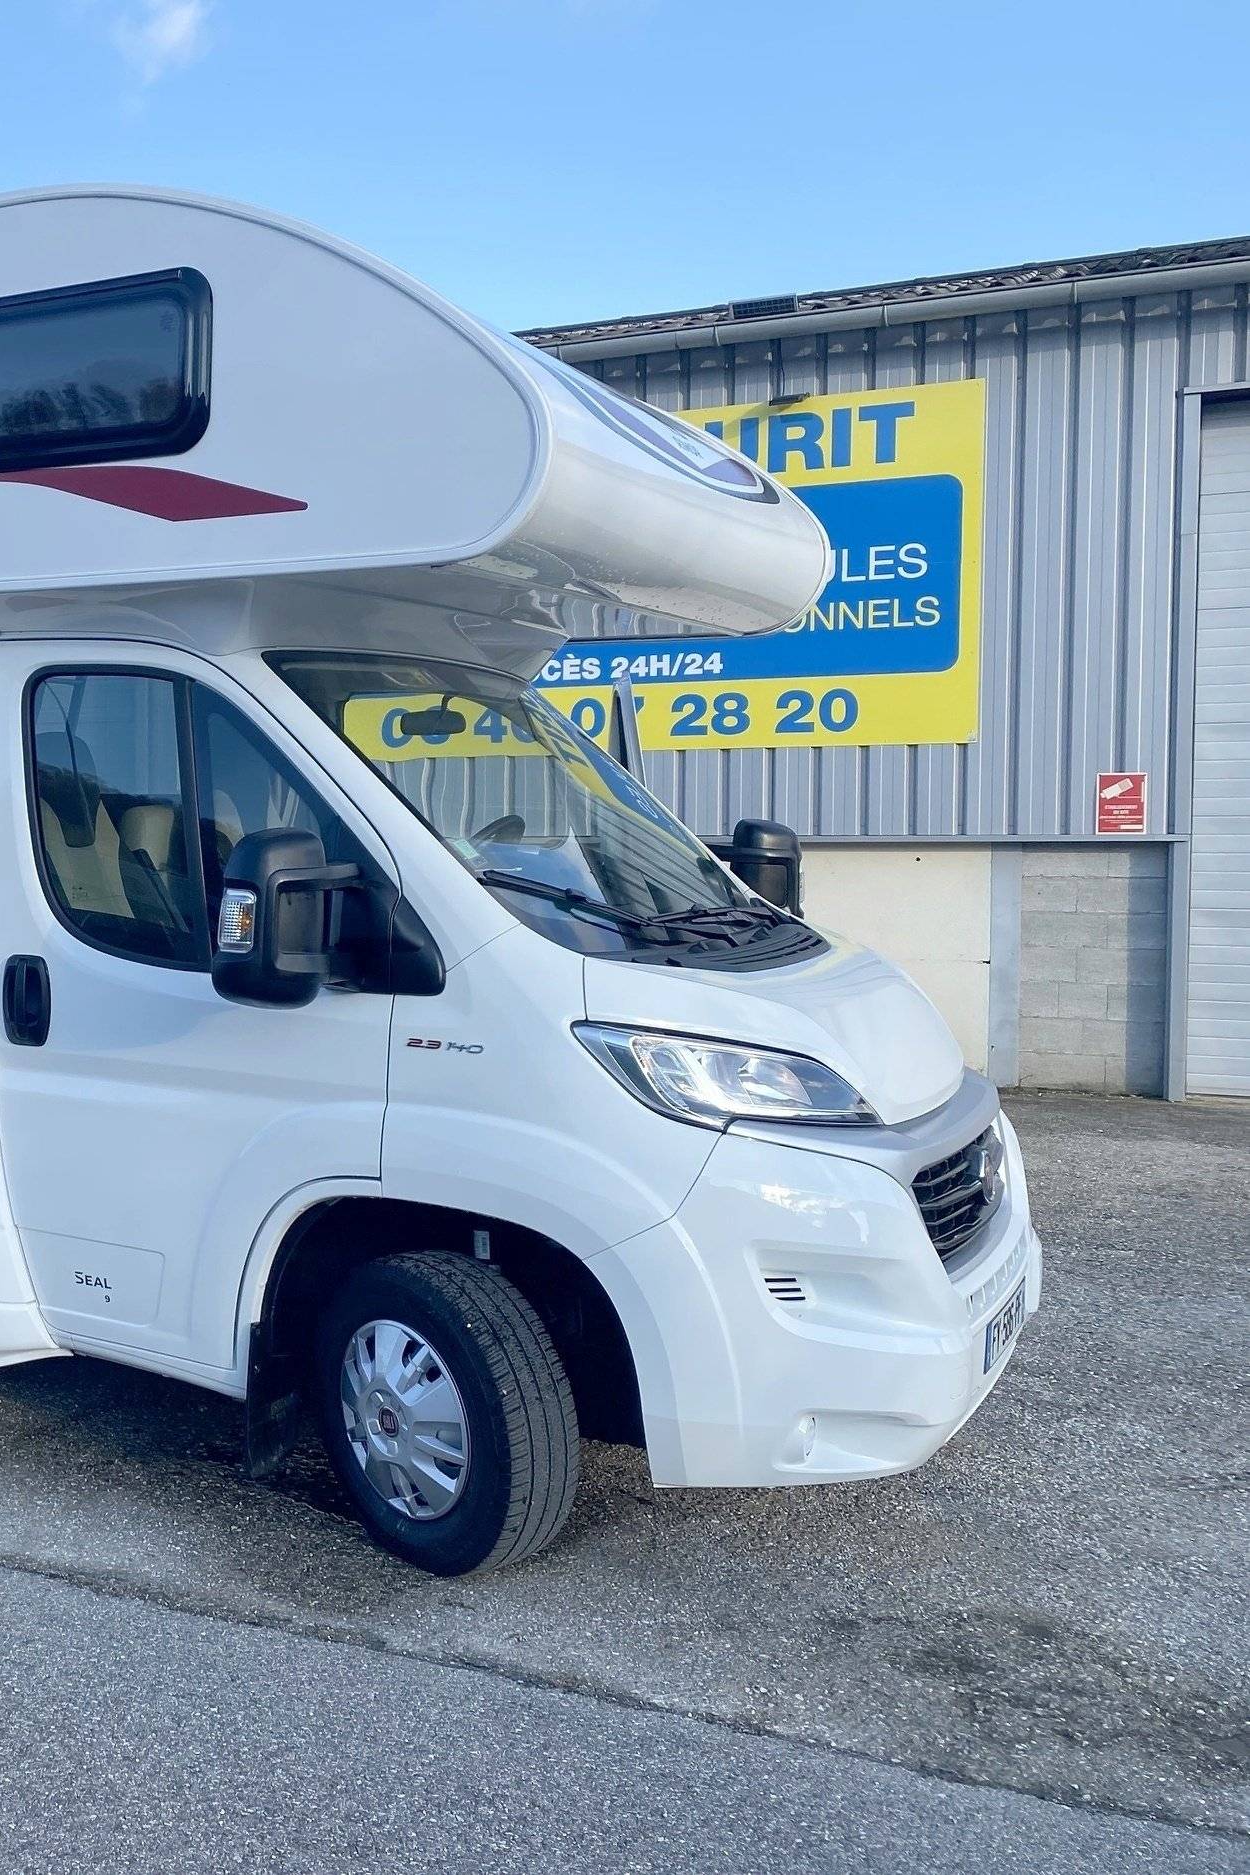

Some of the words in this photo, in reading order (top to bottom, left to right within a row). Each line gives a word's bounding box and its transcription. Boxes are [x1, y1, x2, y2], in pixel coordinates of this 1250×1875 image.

[533, 653, 600, 682] CÈS
[611, 652, 724, 678] 24H/24
[570, 697, 645, 738] 0
[670, 693, 750, 737] 28
[775, 688, 858, 734] 20
[74, 1271, 112, 1289] SEAL
[104, 1295, 111, 1303] 9
